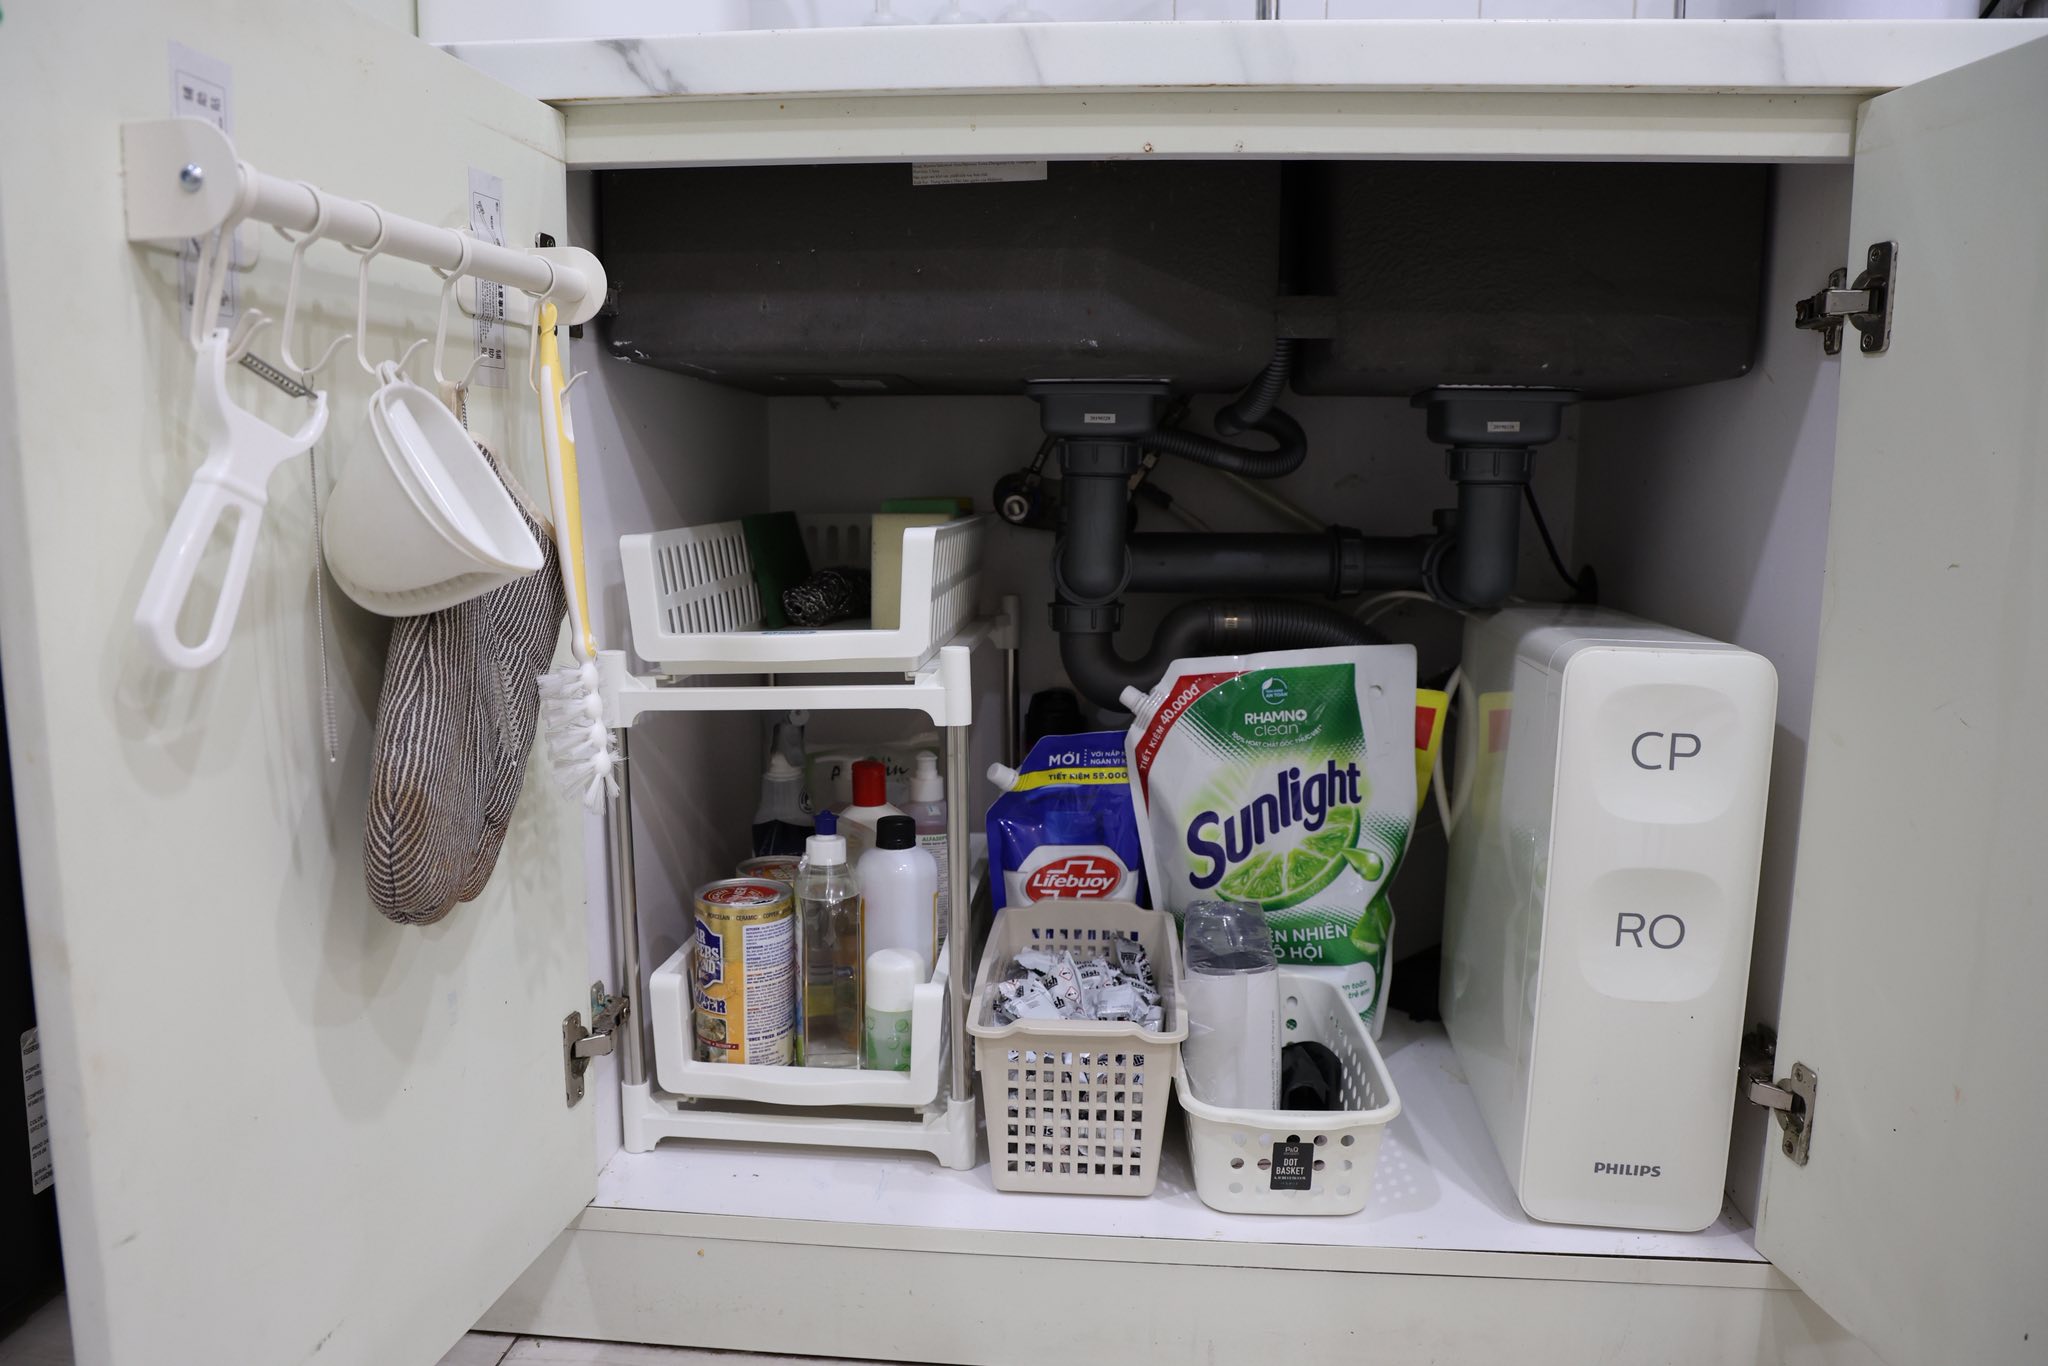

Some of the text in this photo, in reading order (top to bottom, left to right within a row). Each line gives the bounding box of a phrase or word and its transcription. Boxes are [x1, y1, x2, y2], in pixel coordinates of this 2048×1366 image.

[1244, 709, 1307, 725] RHAMNO
[1254, 724, 1298, 737] clean
[1048, 751, 1080, 766] MỚI
[1139, 749, 1152, 769] TIẾT
[1631, 731, 1702, 771] CP
[1187, 760, 1362, 889] Sunlight
[1032, 874, 1116, 890] Lifebuoy
[1292, 922, 1348, 942] NHIÊN
[1615, 912, 1686, 950] RO
[1290, 943, 1323, 961] HỘI
[1283, 1158, 1298, 1166] DOT
[1594, 1162, 1661, 1177] PHILIPS
[1275, 1166, 1305, 1175] BASKET
